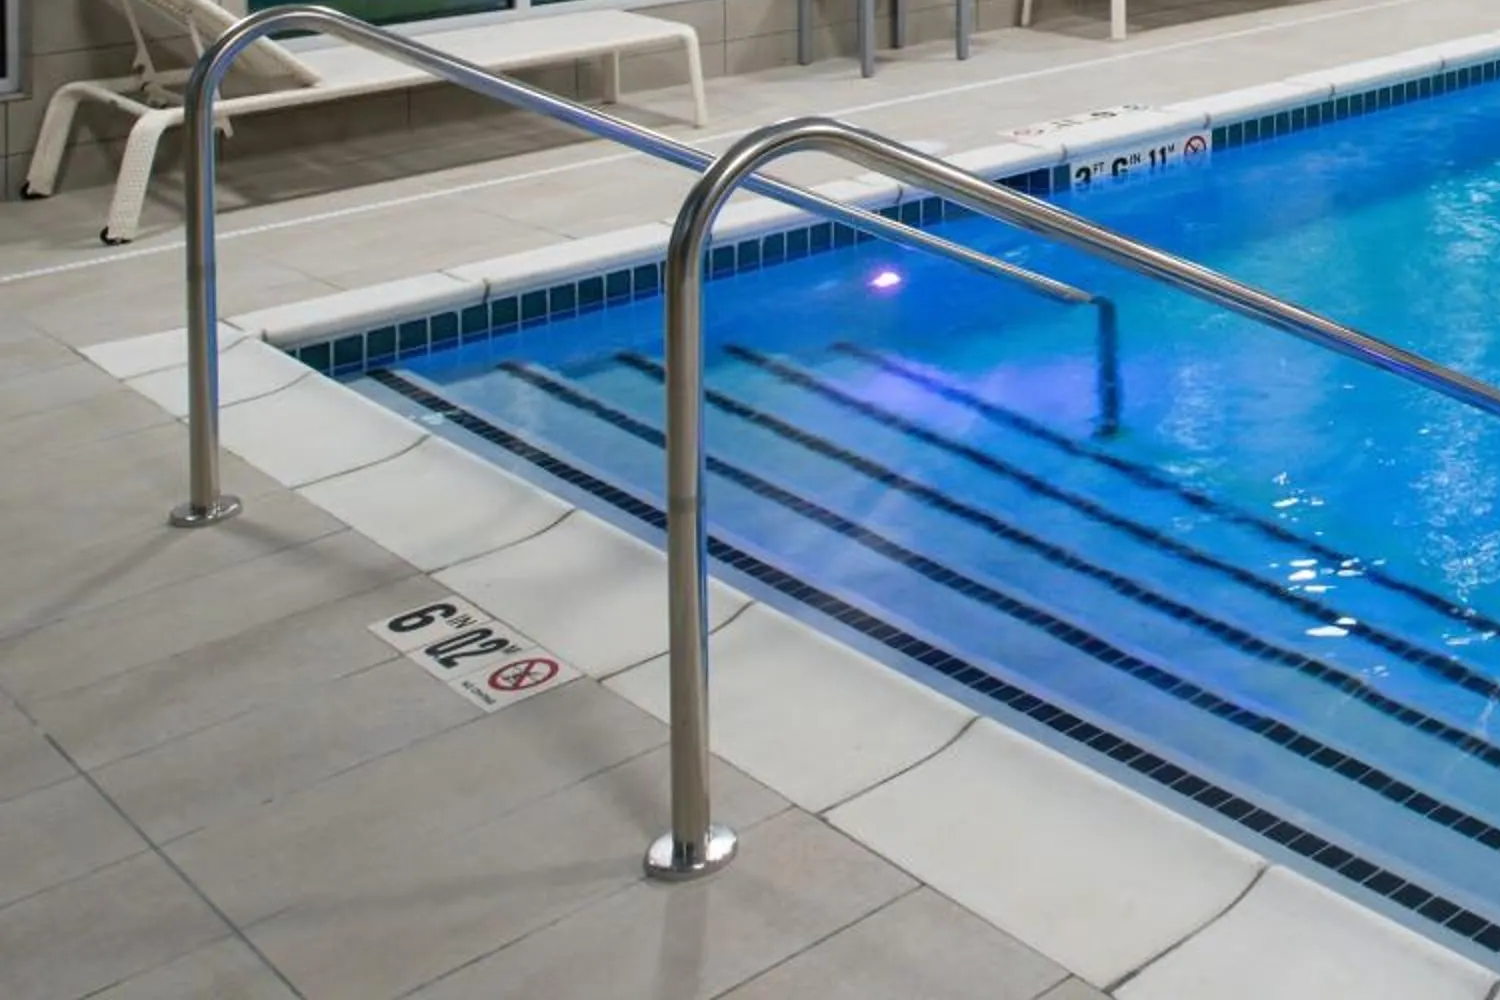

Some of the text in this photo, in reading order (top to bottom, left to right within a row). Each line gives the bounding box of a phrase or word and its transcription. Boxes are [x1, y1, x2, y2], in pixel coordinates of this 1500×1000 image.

[1093, 162, 1105, 174] FT
[1129, 152, 1141, 165] IN
[387, 603, 457, 632] 6
